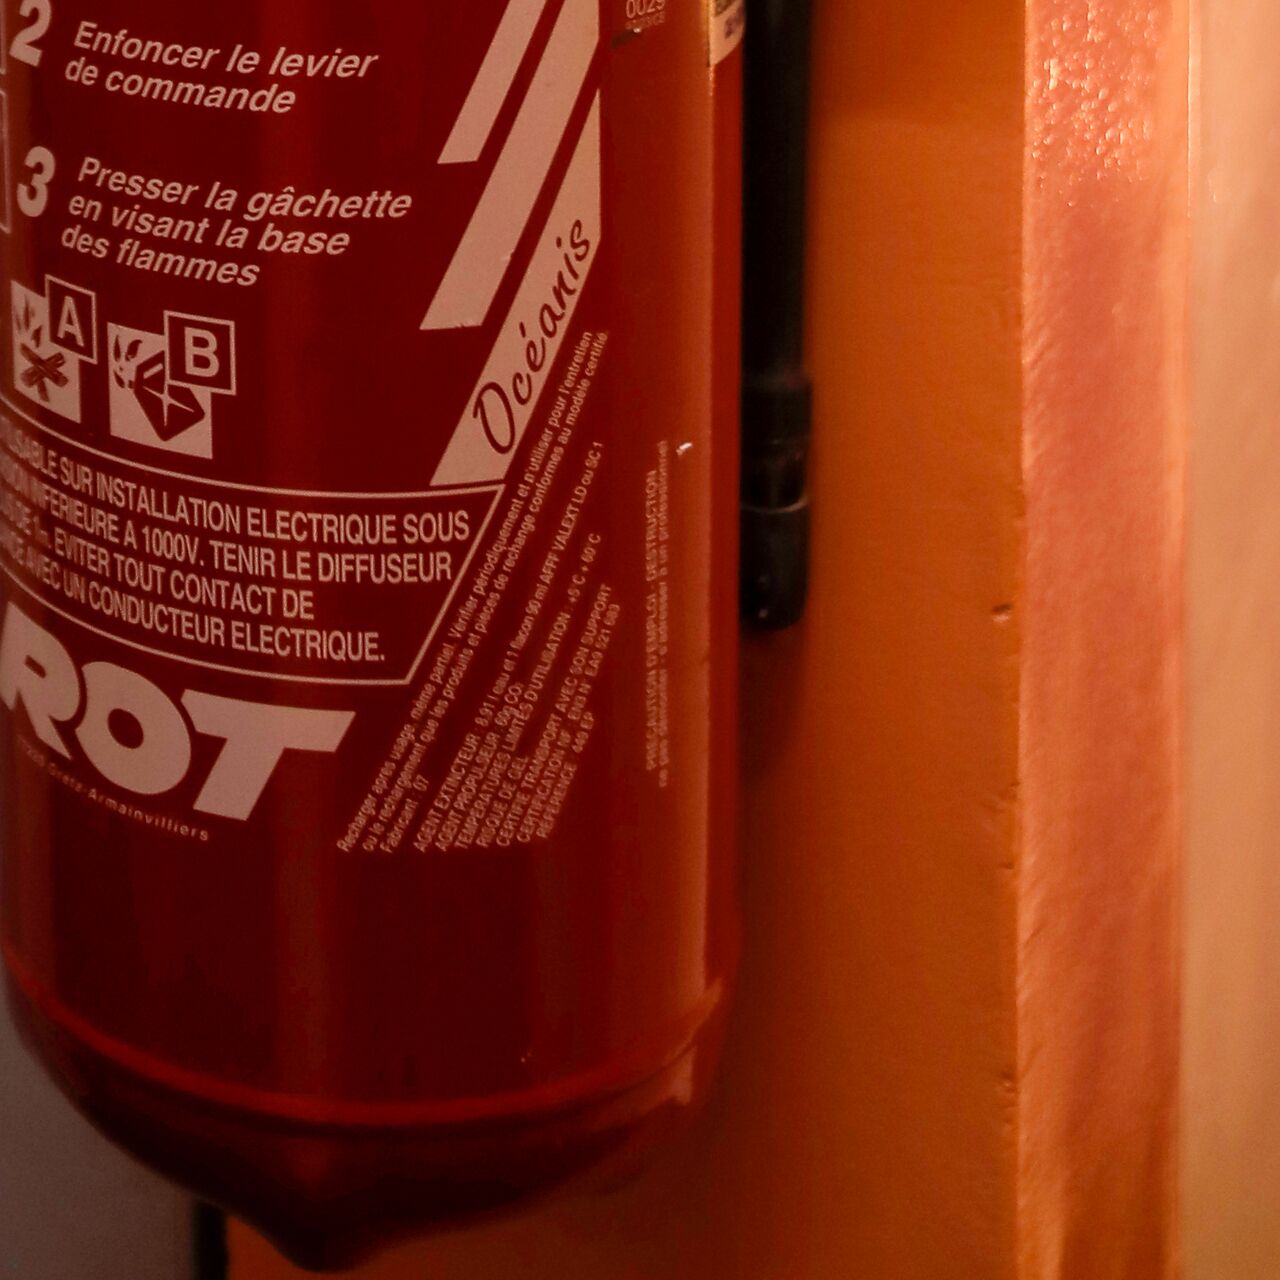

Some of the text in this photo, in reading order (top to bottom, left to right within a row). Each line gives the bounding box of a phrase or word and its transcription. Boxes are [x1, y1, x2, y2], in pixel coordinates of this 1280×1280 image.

[74, 21, 221, 70] Enfoncer
[226, 45, 259, 74] le
[268, 47, 379, 78] levier
[65, 57, 297, 113] de commande
[17, 146, 412, 222] 3 Presser la gâchette
[69, 195, 351, 255] en visant la base
[62, 225, 260, 287] des flammes
[57, 296, 84, 347] A
[474, 218, 592, 455] Océanis
[184, 327, 220, 377] B
[557, 331, 593, 395] l'entretien
[547, 396, 567, 428] pour
[559, 378, 590, 426] modèle
[523, 427, 554, 483] n'utiliser
[557, 427, 572, 445] au
[584, 449, 602, 469] SC
[60, 456, 92, 496] SUR
[97, 473, 240, 534] INSTALLATION
[247, 506, 396, 545] ELECTRIQUE
[403, 510, 469, 543] SOUS
[517, 483, 531, 498] et
[528, 446, 564, 513] conformes
[570, 485, 588, 504] LD
[581, 469, 594, 486] ou
[30, 479, 119, 543] INFERIEURE
[124, 520, 137, 549] A
[209, 540, 276, 578] TENIR
[283, 550, 311, 581] LE
[318, 551, 452, 584] DIFFUSEUR
[472, 498, 522, 596] périodiquement
[502, 513, 536, 573] rechange
[551, 503, 580, 551] VALEXT
[645, 469, 660, 581] DESTRUCTION
[55, 528, 110, 577] EVITER
[113, 552, 166, 594] TOUT
[171, 571, 277, 618] CONTACT
[283, 588, 314, 619] DE
[492, 573, 509, 590] de
[539, 551, 560, 584] AFFF
[63, 571, 86, 603] UN
[89, 581, 225, 646] CONDUCTEUR
[231, 620, 386, 661] ELECTRIQUE.
[447, 594, 479, 638] Vérifier
[467, 632, 481, 647] et
[509, 615, 535, 650] flacon
[442, 647, 474, 700] produits
[492, 672, 511, 695] eau
[503, 658, 516, 672] et
[520, 712, 563, 789] TRANSPORT
[554, 676, 578, 713] AVEC
[568, 646, 590, 675] SON
[580, 583, 613, 645] SUPPORT
[419, 718, 440, 743] que
[429, 699, 449, 718] les
[377, 742, 427, 823] rechargement
[433, 733, 481, 810] EXTINCTEUR
[434, 809, 463, 852] AGENT
[452, 731, 501, 812] PROPULSEUR
[453, 751, 508, 849] TEMPERATURES
[501, 702, 534, 752] LIMITES
[511, 748, 568, 843] CERTIFICATION
[336, 793, 377, 853] Recharger
[369, 822, 385, 835] le
[379, 774, 429, 854] Fabricant 07
[475, 756, 530, 848] RISQUE DE GEL
[362, 835, 378, 851] ou
[412, 808, 443, 853] AGENT
